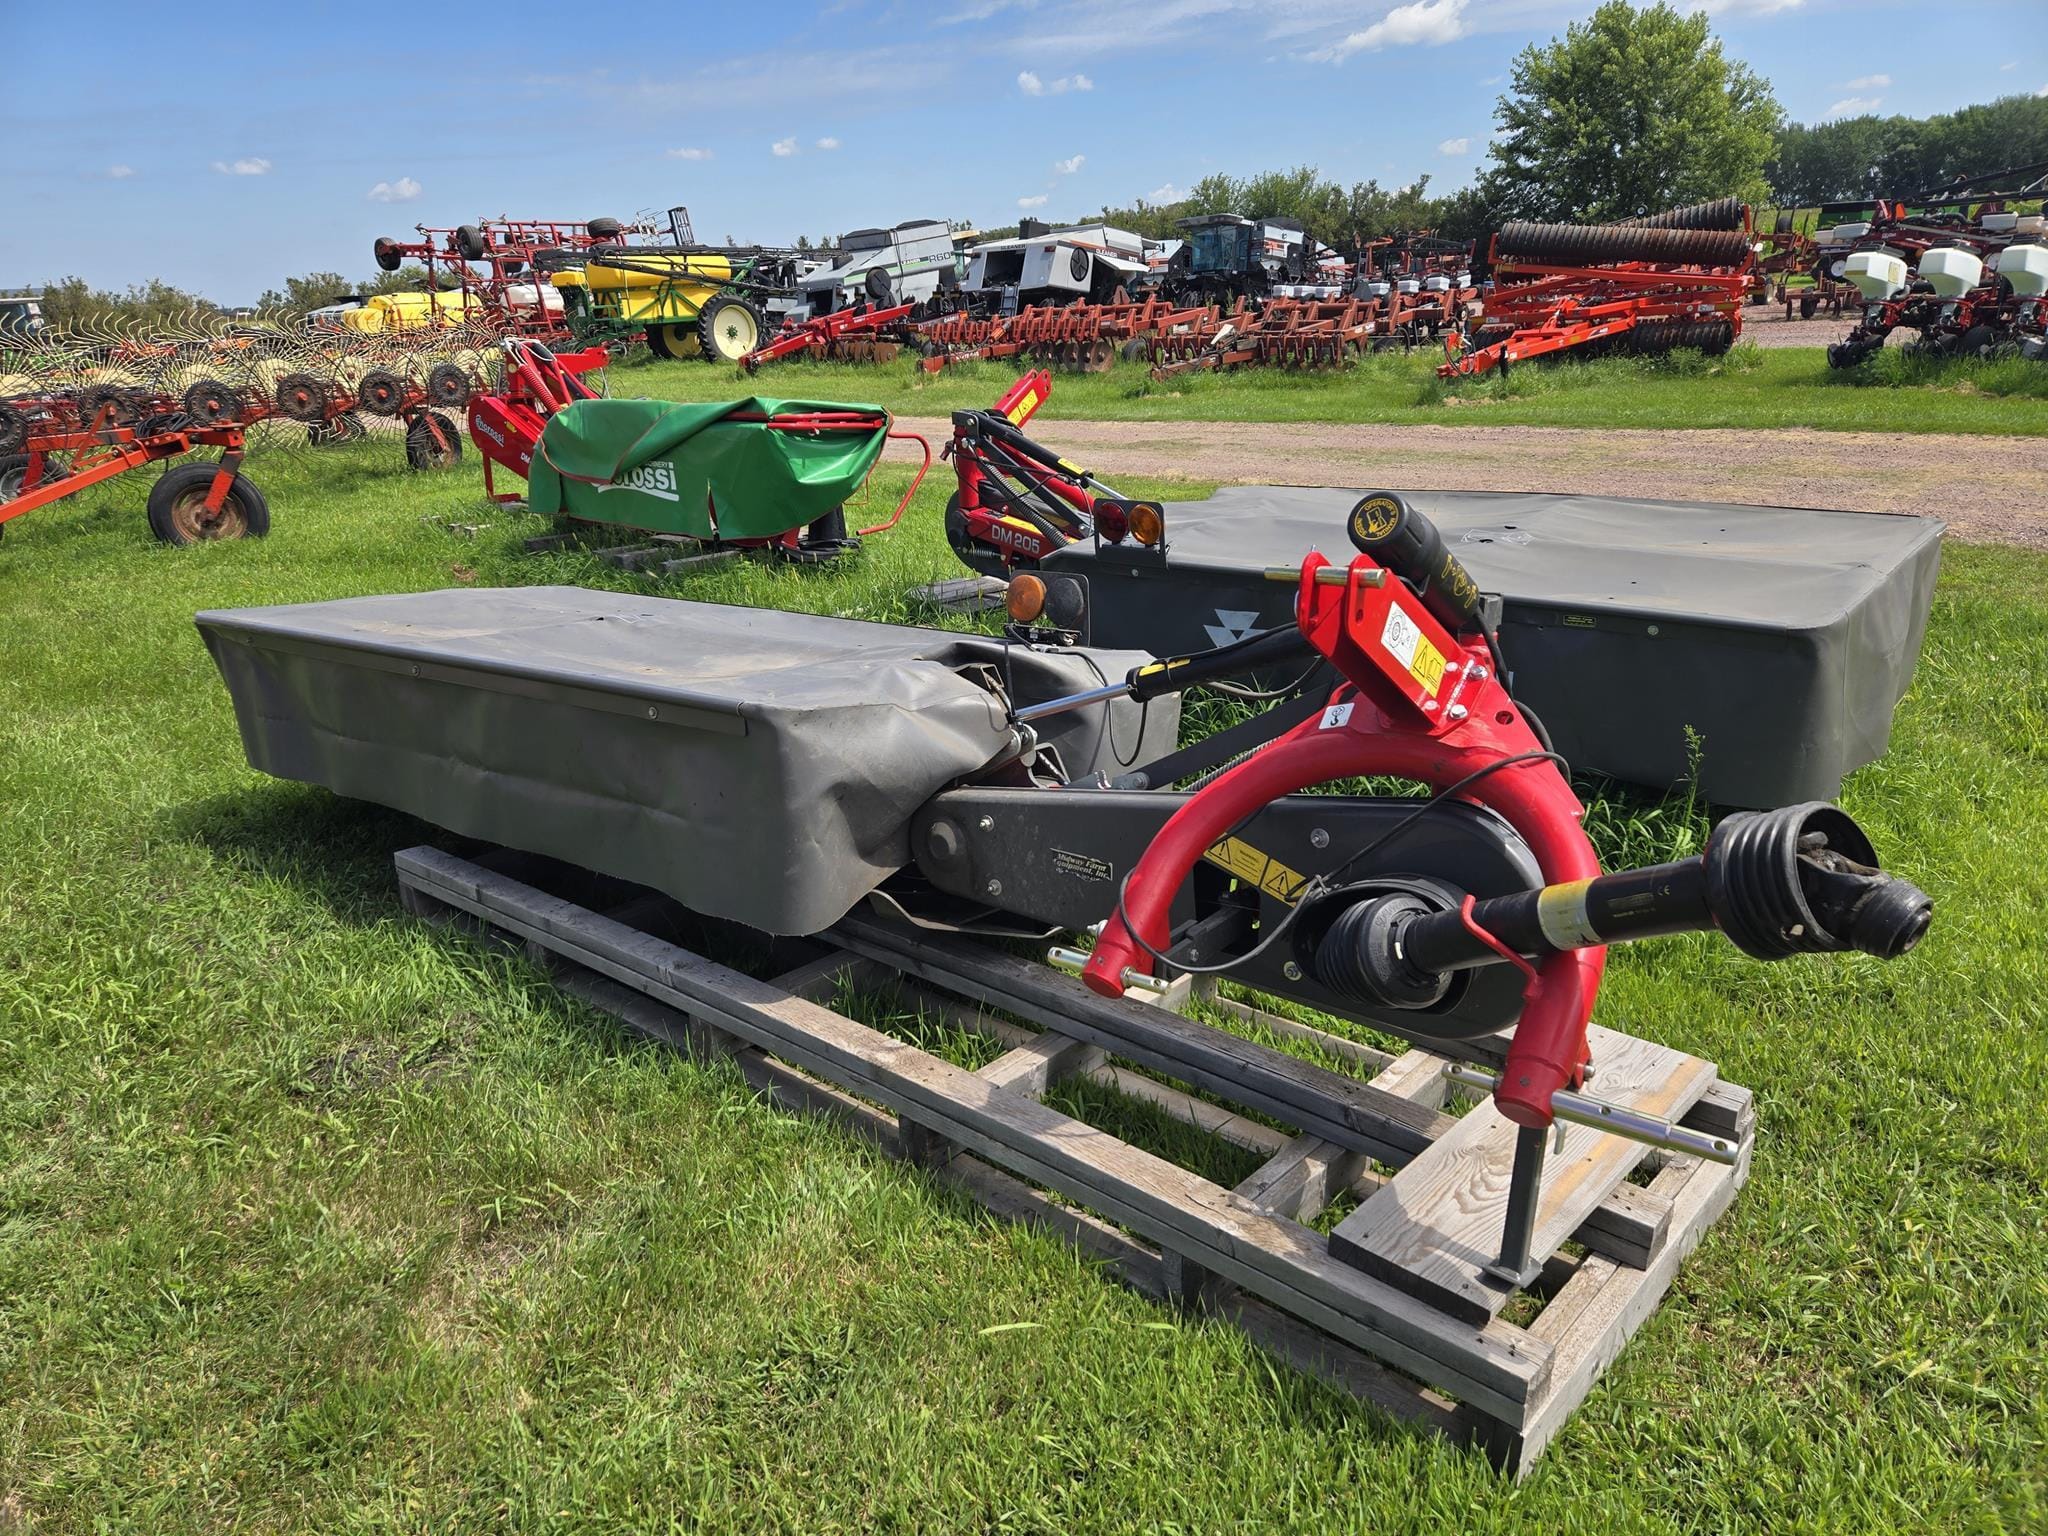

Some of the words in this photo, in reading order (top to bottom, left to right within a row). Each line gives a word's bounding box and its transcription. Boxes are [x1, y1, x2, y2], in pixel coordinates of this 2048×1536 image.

[928, 251, 951, 263] R60
[992, 525, 1012, 544] DM
[1014, 533, 1040, 553] 205
[1085, 861, 1107, 872] Farm
